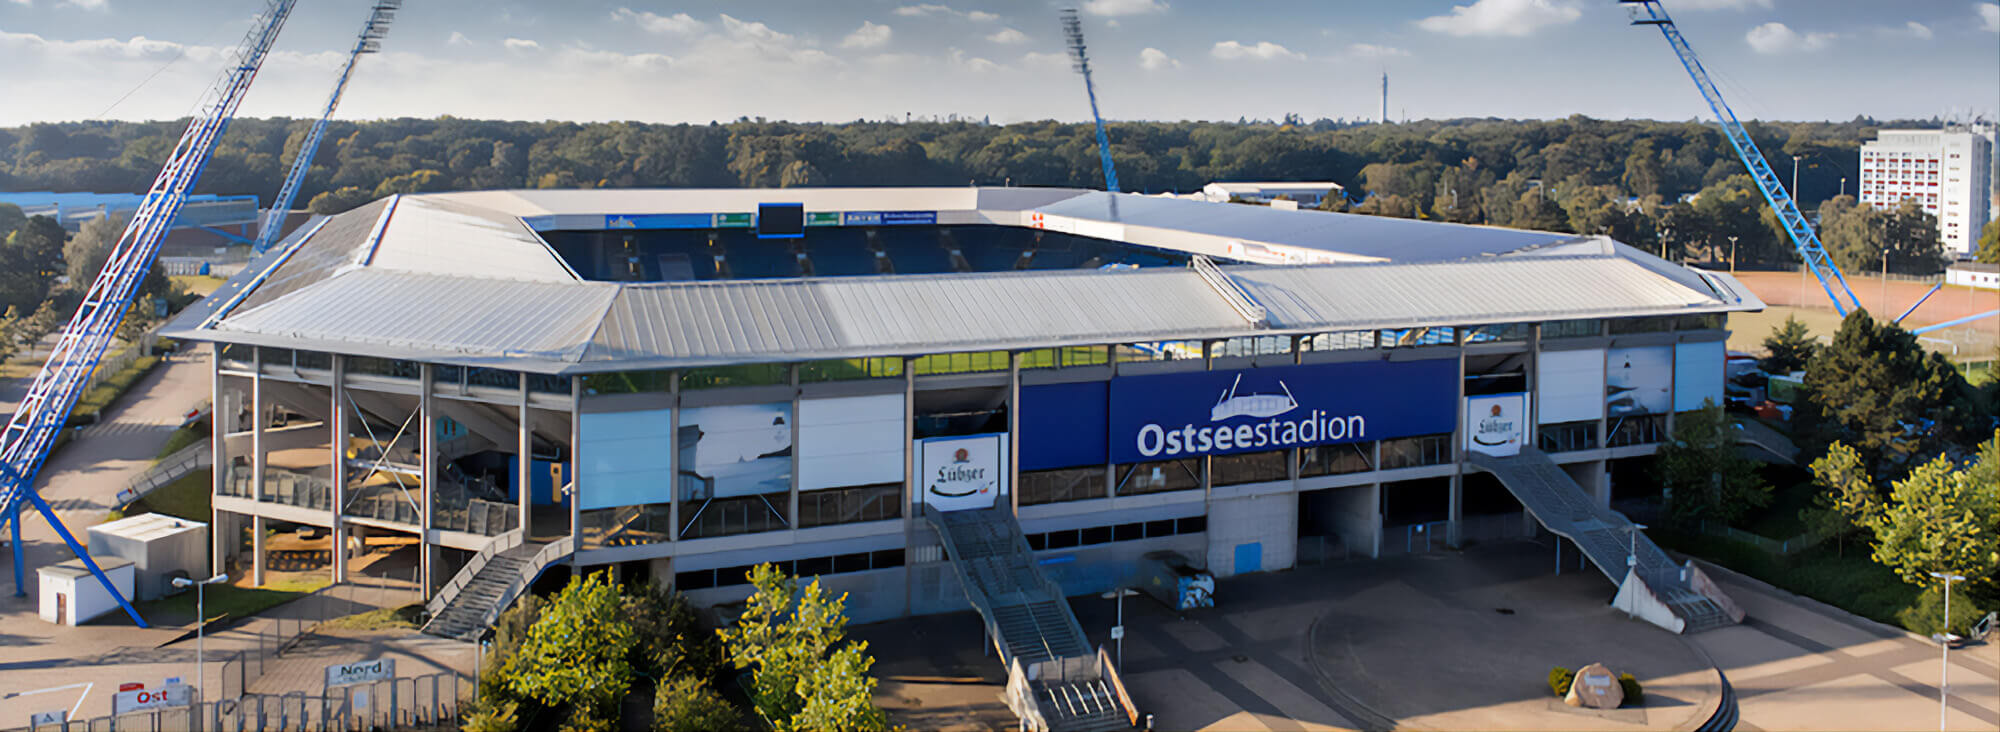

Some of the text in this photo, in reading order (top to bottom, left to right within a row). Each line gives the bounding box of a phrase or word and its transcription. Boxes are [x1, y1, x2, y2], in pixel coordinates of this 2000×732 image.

[1137, 409, 1364, 456] Ostseestadion
[936, 465, 985, 483] Lübzer
[341, 662, 382, 676] Nord
[136, 690, 168, 704] Ost
